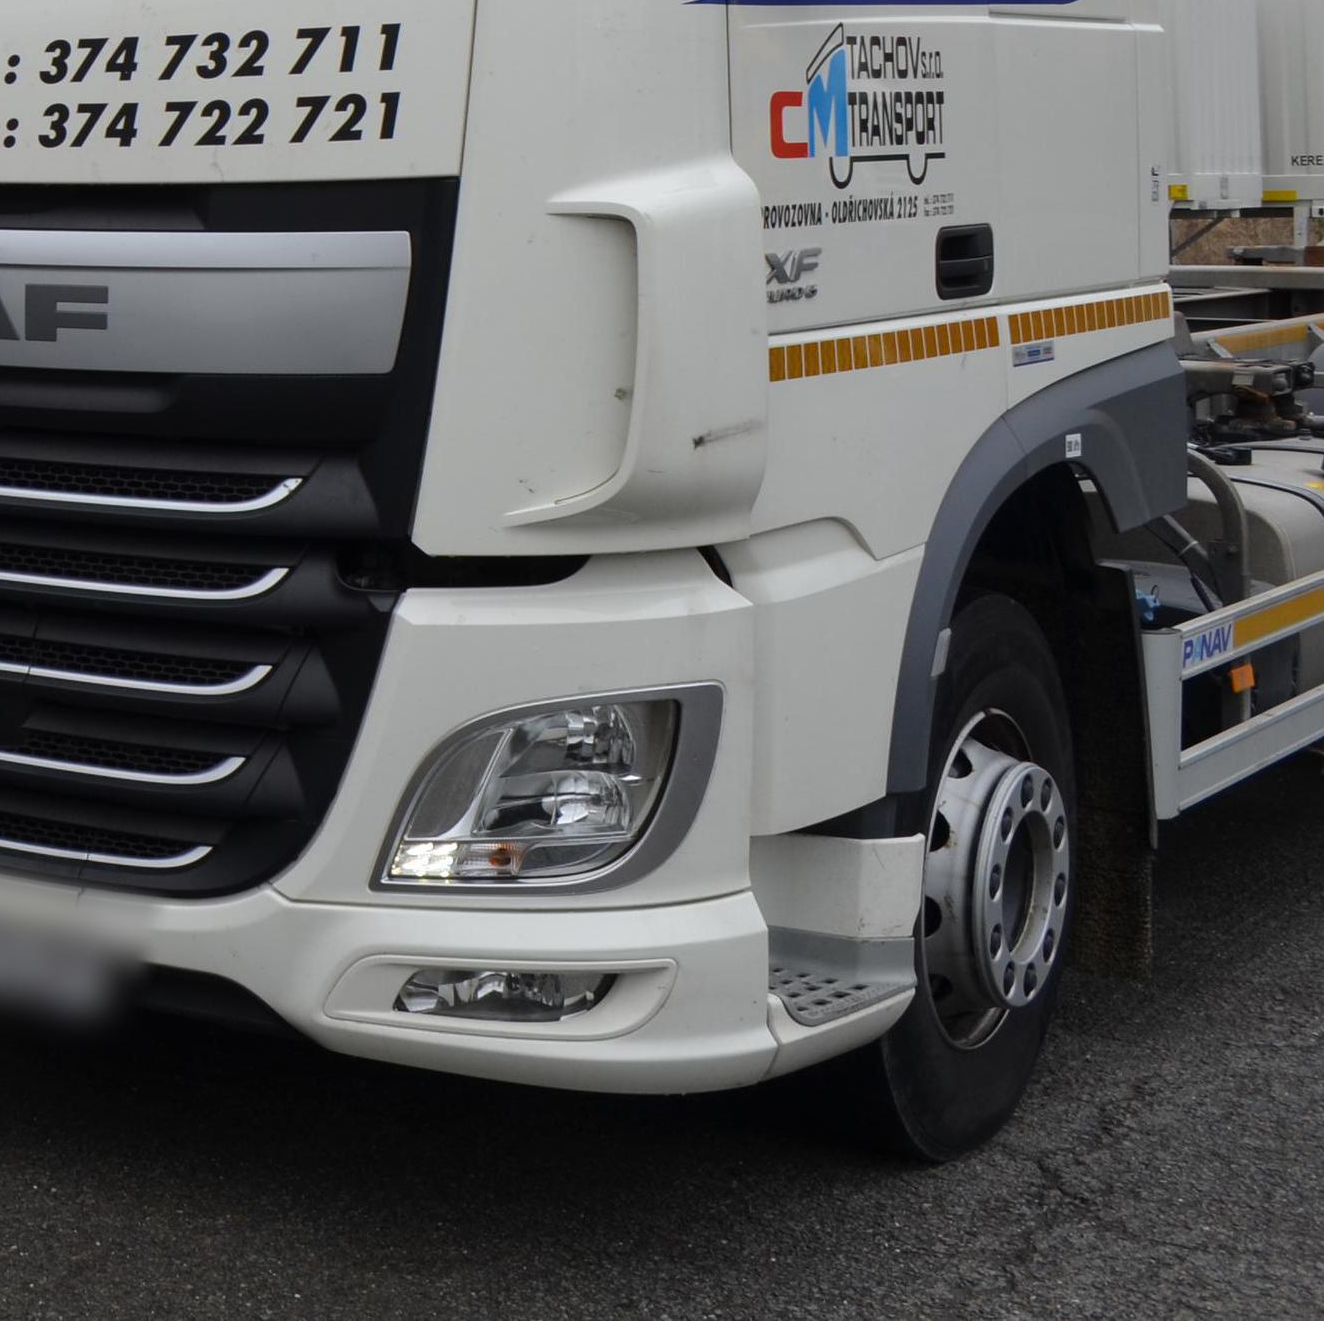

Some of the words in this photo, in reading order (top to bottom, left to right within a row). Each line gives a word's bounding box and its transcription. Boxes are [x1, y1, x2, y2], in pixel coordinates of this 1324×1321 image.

[39, 35, 139, 84] 374
[158, 30, 269, 80] 732
[289, 23, 402, 76] 711
[846, 36, 920, 79] TACHOV
[38, 102, 139, 149] 374
[158, 98, 269, 148] 722
[289, 92, 402, 144] 721
[769, 49, 849, 159] CM
[848, 90, 945, 147] TRANSPORT
[1291, 155, 1323, 166] KERE
[762, 201, 822, 229] ROVOZOVNA
[832, 191, 894, 224] OLDŘICHOVSKÁ
[897, 196, 918, 219] 2125
[765, 248, 822, 285] XF
